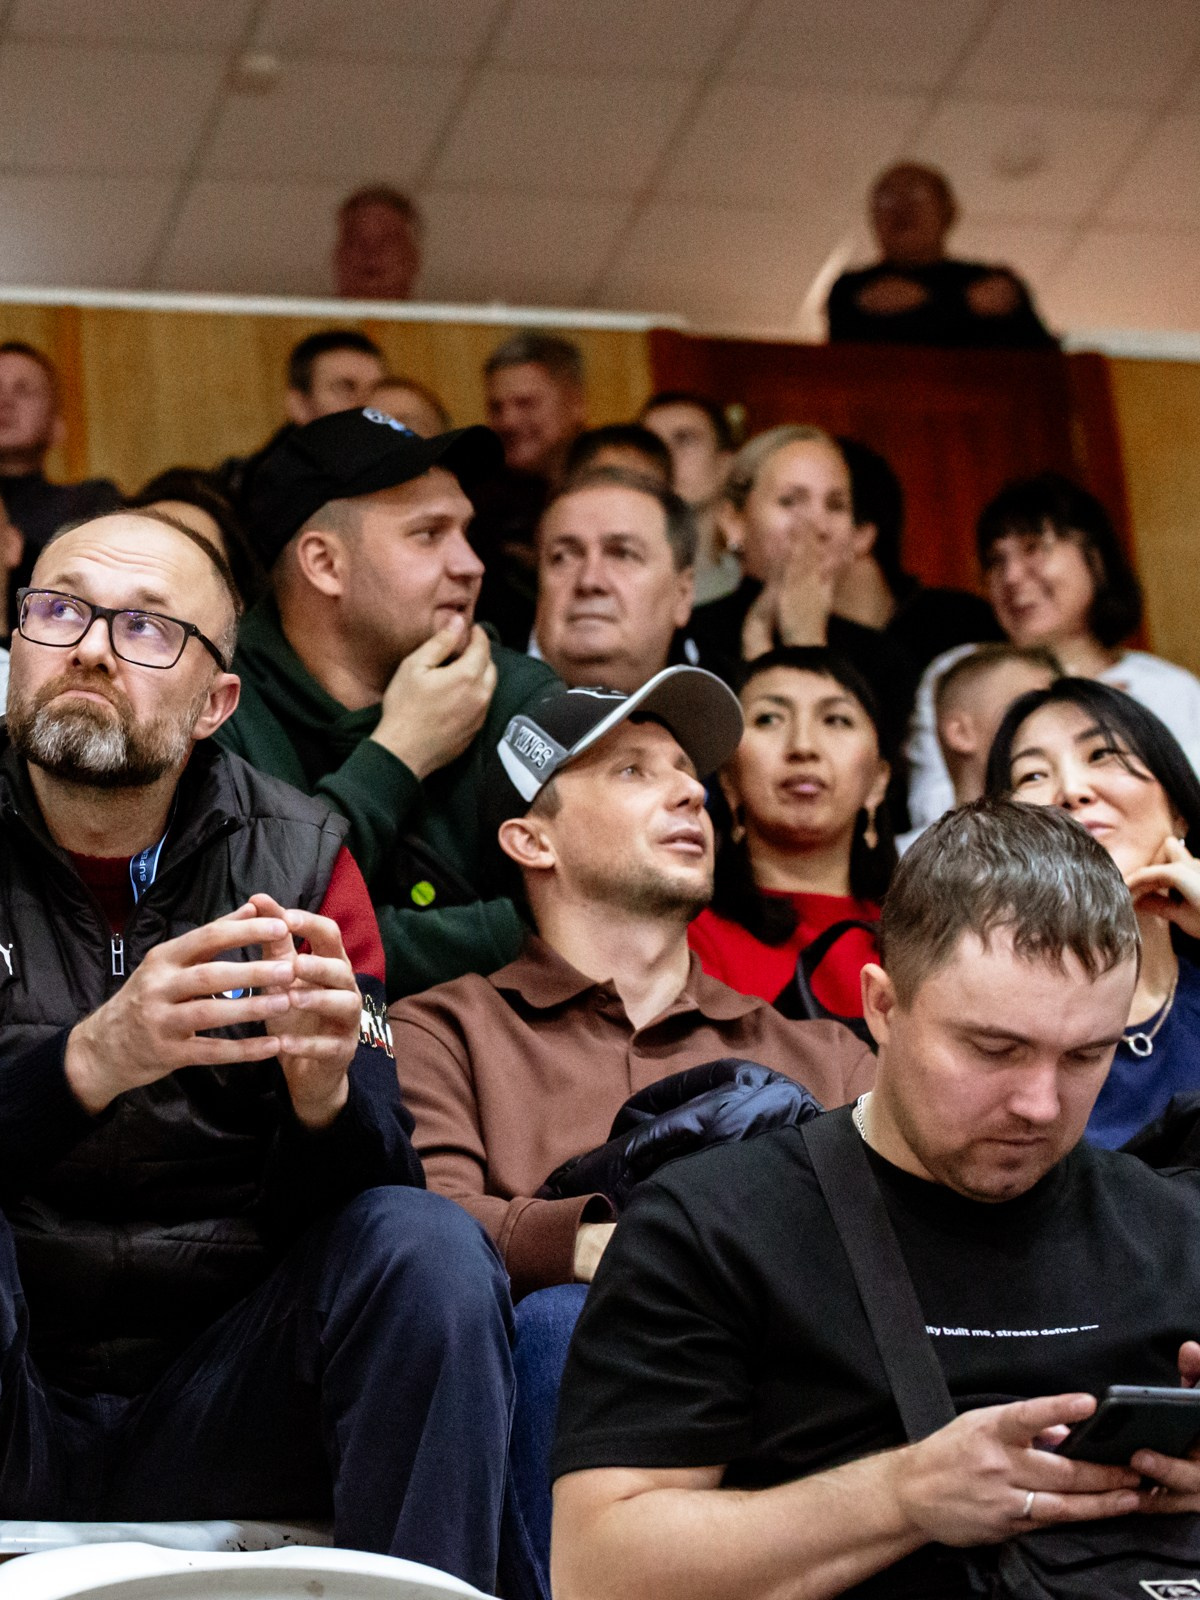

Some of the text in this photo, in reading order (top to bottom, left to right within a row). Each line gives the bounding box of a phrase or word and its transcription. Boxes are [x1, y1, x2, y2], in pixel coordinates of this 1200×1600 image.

[514, 726, 555, 770] KINGS
[943, 1326, 970, 1336] built
[972, 1329, 994, 1338] me,
[995, 1328, 1039, 1338] streets
[1040, 1326, 1079, 1336] define
